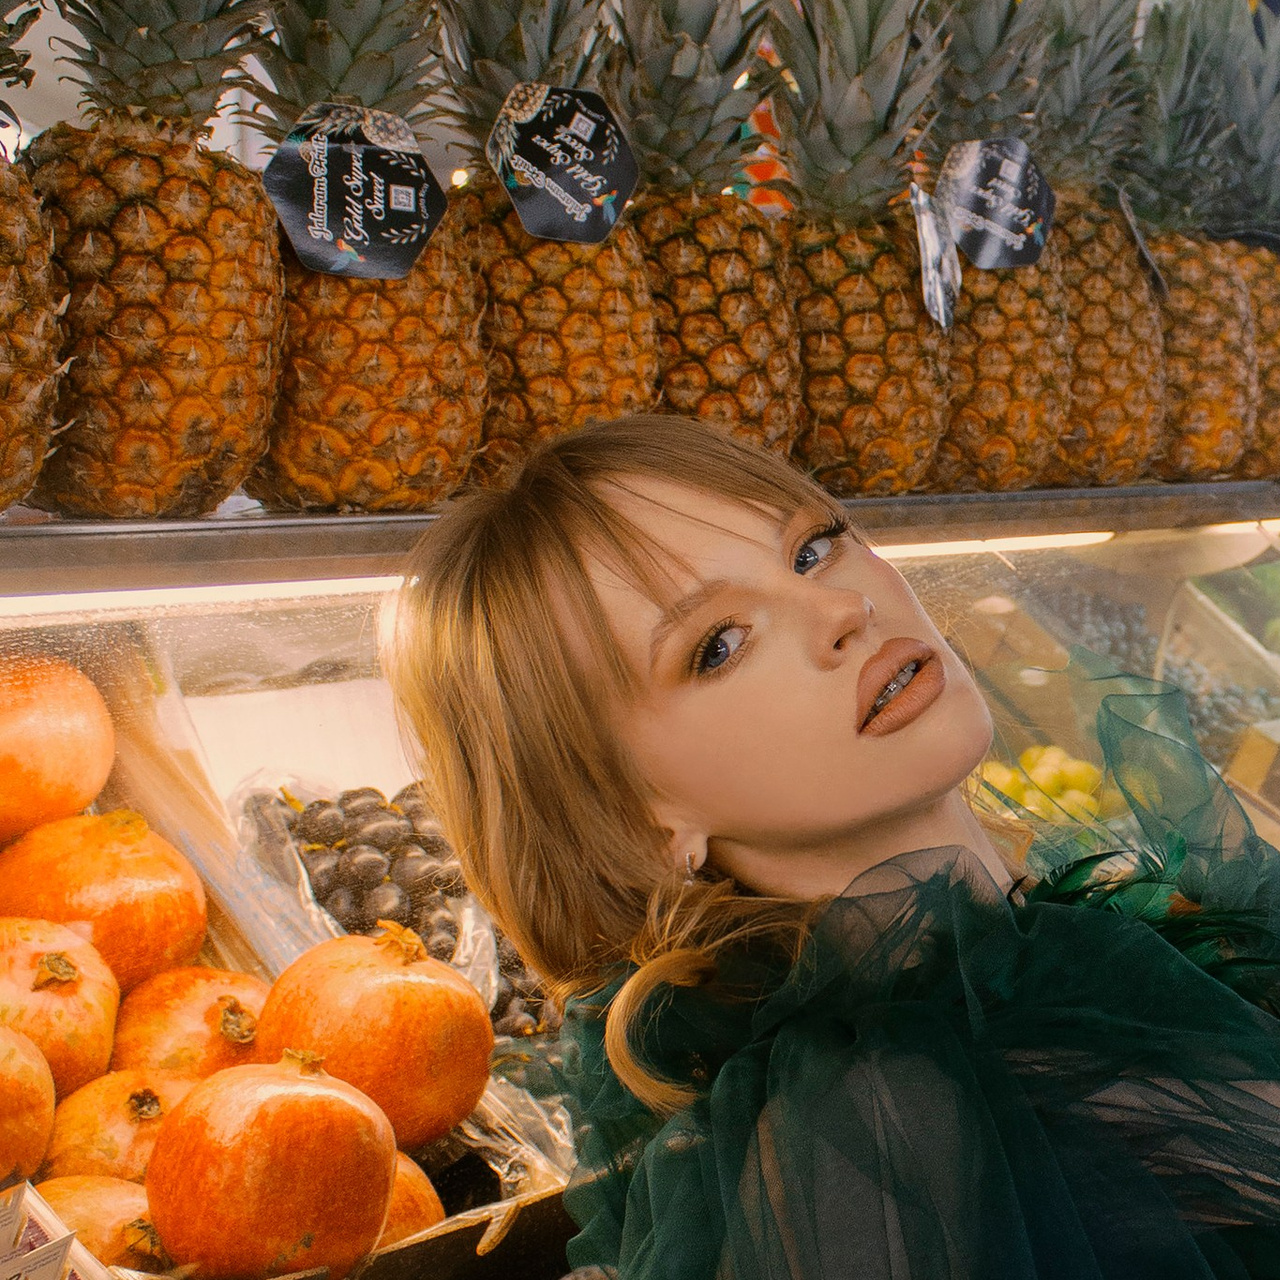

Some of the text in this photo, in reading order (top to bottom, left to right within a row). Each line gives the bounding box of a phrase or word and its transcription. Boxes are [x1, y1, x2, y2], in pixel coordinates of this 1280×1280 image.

[531, 134, 607, 197] Gold Super
[553, 132, 594, 161] Sweet
[307, 133, 333, 242] Jalaram Fruit
[343, 148, 370, 246] Gold Super
[365, 171, 386, 220] Sweet
[510, 154, 592, 222] Jalaram Fruit
